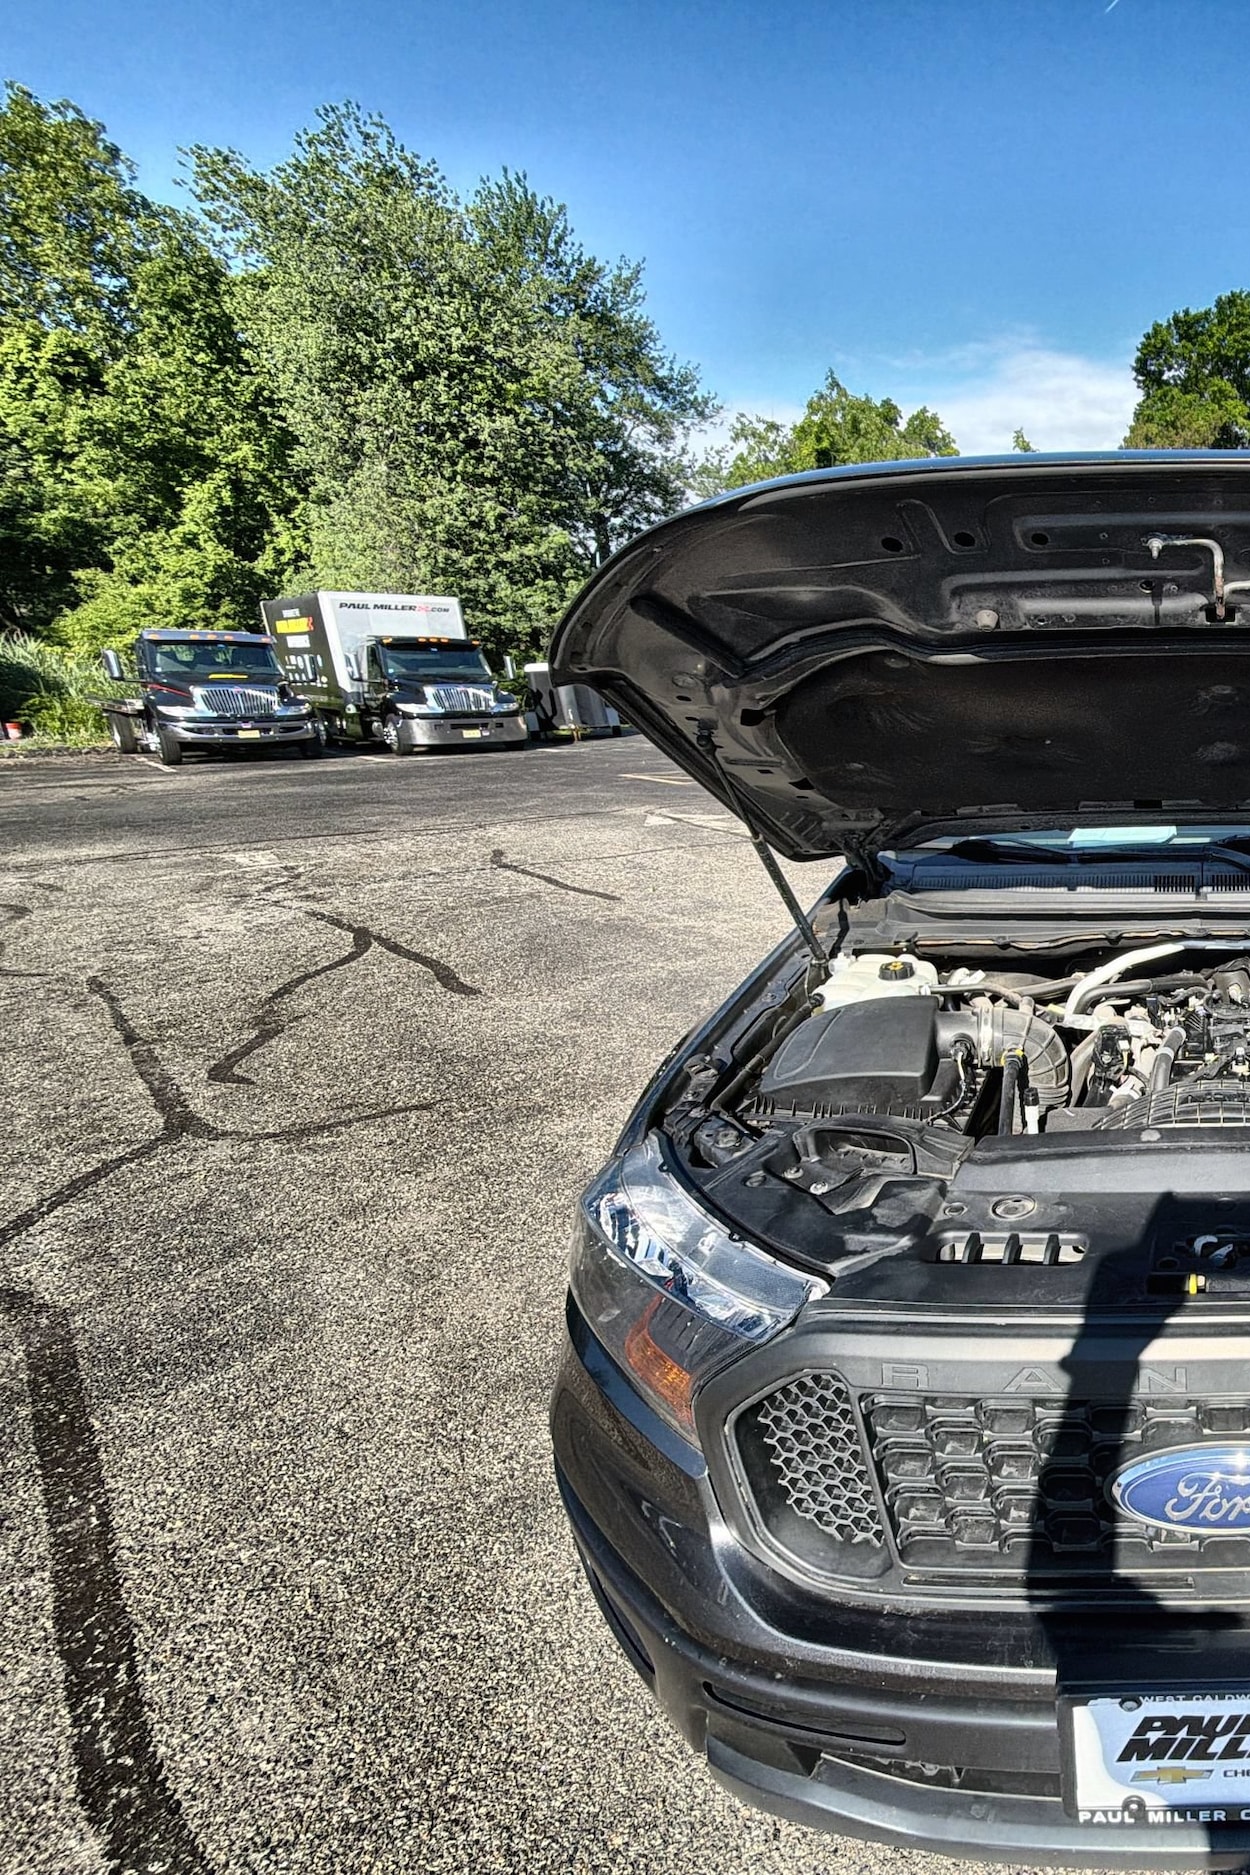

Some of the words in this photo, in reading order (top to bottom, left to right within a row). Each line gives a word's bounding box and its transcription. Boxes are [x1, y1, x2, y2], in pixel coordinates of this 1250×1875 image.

[339, 602, 371, 610] PAUL
[373, 603, 417, 612] MILLER
[1078, 1809, 1136, 1824] PAUL
[1148, 1808, 1227, 1823] MILLER
